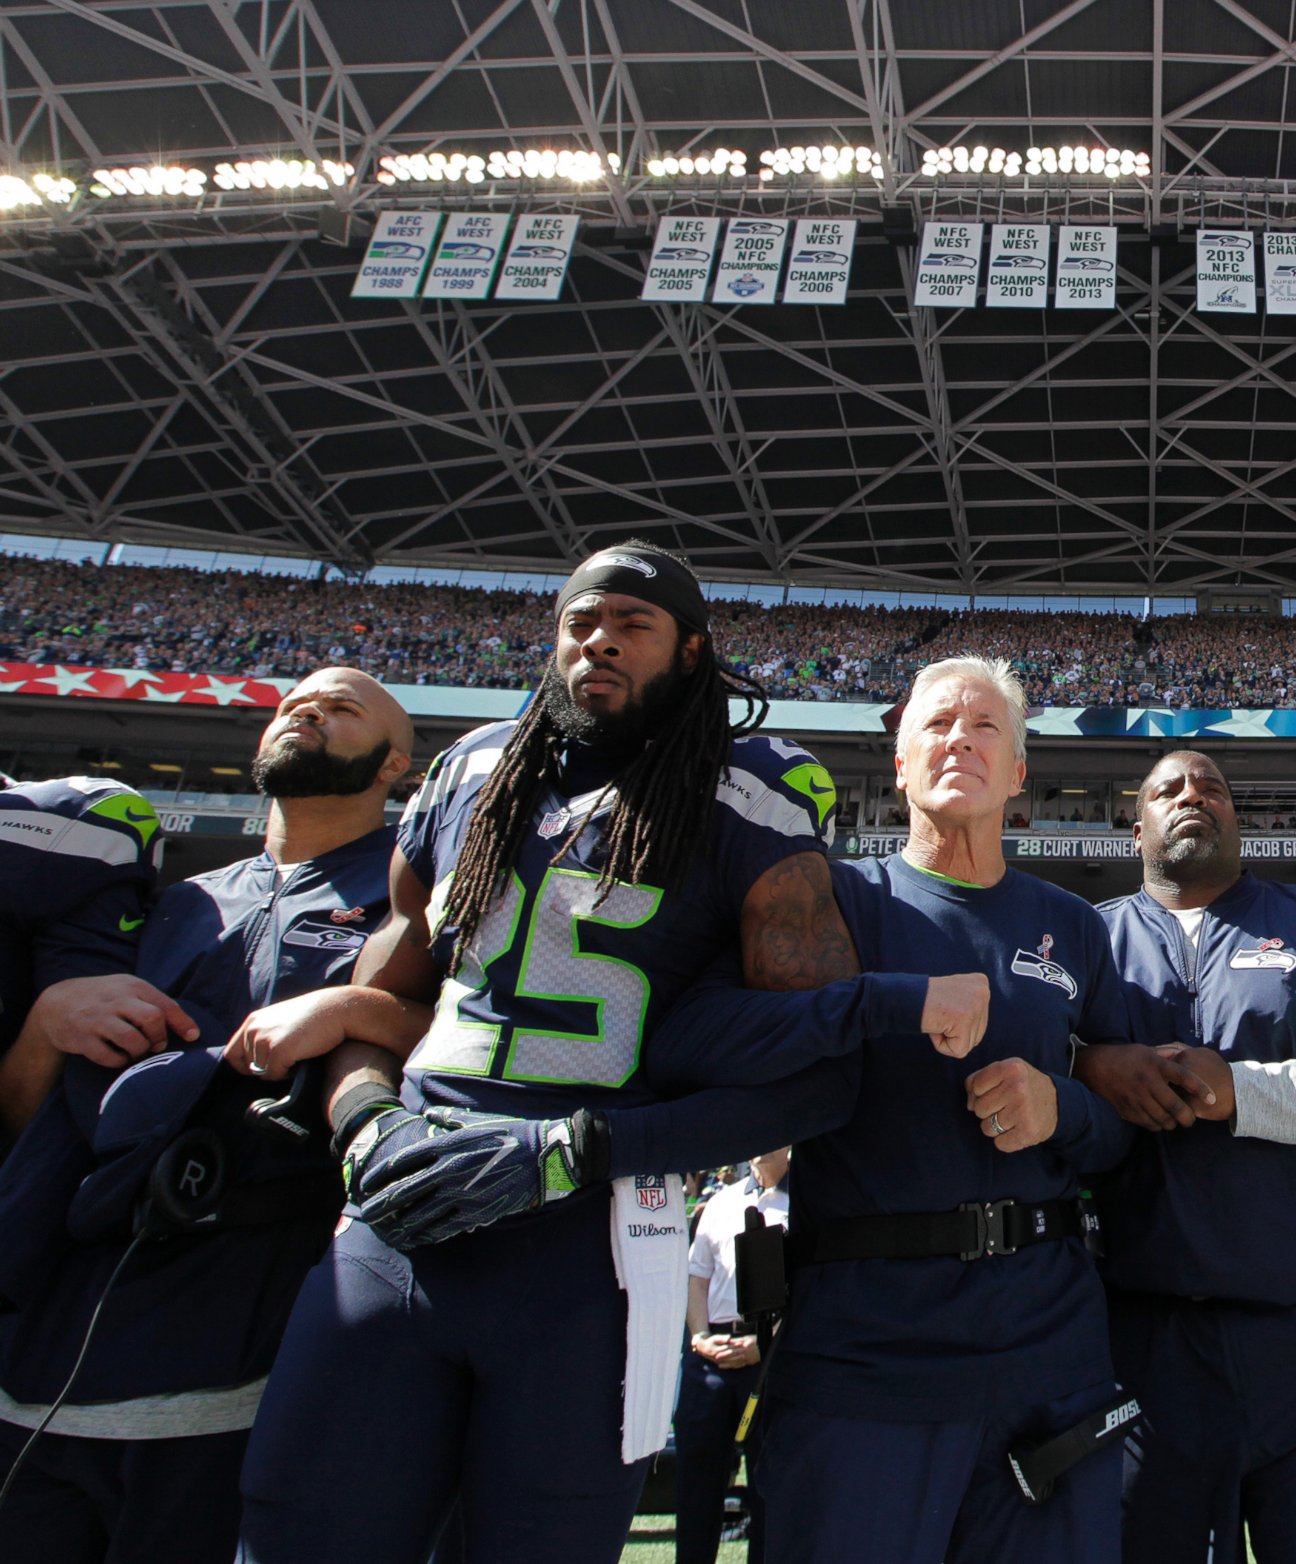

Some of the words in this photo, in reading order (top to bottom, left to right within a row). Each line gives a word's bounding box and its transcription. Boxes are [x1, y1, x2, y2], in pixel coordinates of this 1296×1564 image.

[395, 216, 422, 226] AFC
[465, 217, 491, 227] AFC
[533, 219, 563, 229] NFC
[674, 221, 704, 231] NFC
[387, 227, 424, 237] WEST
[456, 228, 493, 238] WEST
[526, 229, 565, 240] WEST
[812, 224, 841, 234] NFC
[939, 227, 967, 237] NFC
[1007, 229, 1035, 239] NFC
[668, 232, 707, 242] WEST
[805, 234, 844, 245] WEST
[1074, 231, 1102, 241] NFC
[734, 238, 775, 250] 2005
[933, 238, 971, 248] WEST
[1002, 240, 1039, 249] WEST
[1070, 242, 1106, 252] WEST
[737, 251, 767, 261] NFC
[1206, 250, 1245, 262] 2013
[362, 266, 420, 277] CHAMPS
[504, 266, 563, 277] CHAMPS
[721, 262, 779, 271] CHAMPIONS
[1212, 263, 1240, 273] NFC
[433, 267, 490, 278] CHAMPS
[649, 268, 707, 279] CHAMPS
[790, 271, 846, 282] CHAMPS
[1198, 273, 1254, 283] CHAMPIONS
[371, 278, 404, 288] 1988
[442, 279, 475, 289] 1999
[512, 277, 548, 287] 2004
[658, 279, 693, 290] 2005
[919, 273, 976, 285] CHAMPS
[990, 275, 1045, 286] CHAMPS
[1058, 277, 1114, 288] CHAMPS
[799, 282, 833, 293] 2006
[929, 285, 964, 296] 2007
[1000, 286, 1033, 297] 2010
[1069, 288, 1102, 299] 2013
[719, 779, 752, 799] AWKS
[1, 821, 53, 835] HAWKS
[160, 814, 195, 832] NOR
[859, 837, 893, 854] PETE
[1017, 840, 1041, 856] 28
[1042, 840, 1078, 857] CURT
[1081, 840, 1139, 858] WARNER
[1239, 840, 1281, 857] JACOB
[179, 1159, 206, 1197] R
[638, 1189, 664, 1208] NFL
[628, 1223, 677, 1237] Wilson
